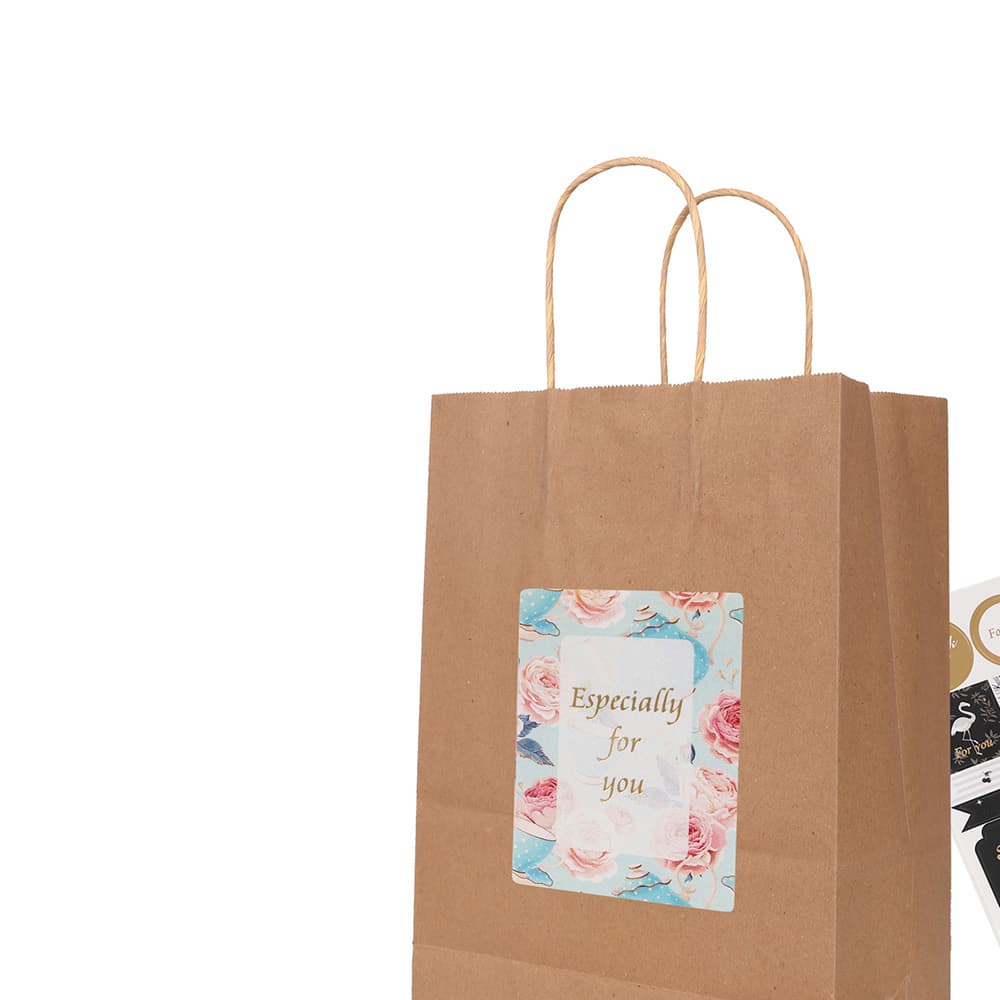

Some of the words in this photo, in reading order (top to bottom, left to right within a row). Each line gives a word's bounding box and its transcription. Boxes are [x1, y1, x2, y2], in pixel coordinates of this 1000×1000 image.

[571, 686, 685, 726] Especially
[597, 725, 642, 761] for
[954, 746, 971, 759] For
[600, 774, 645, 802] you
